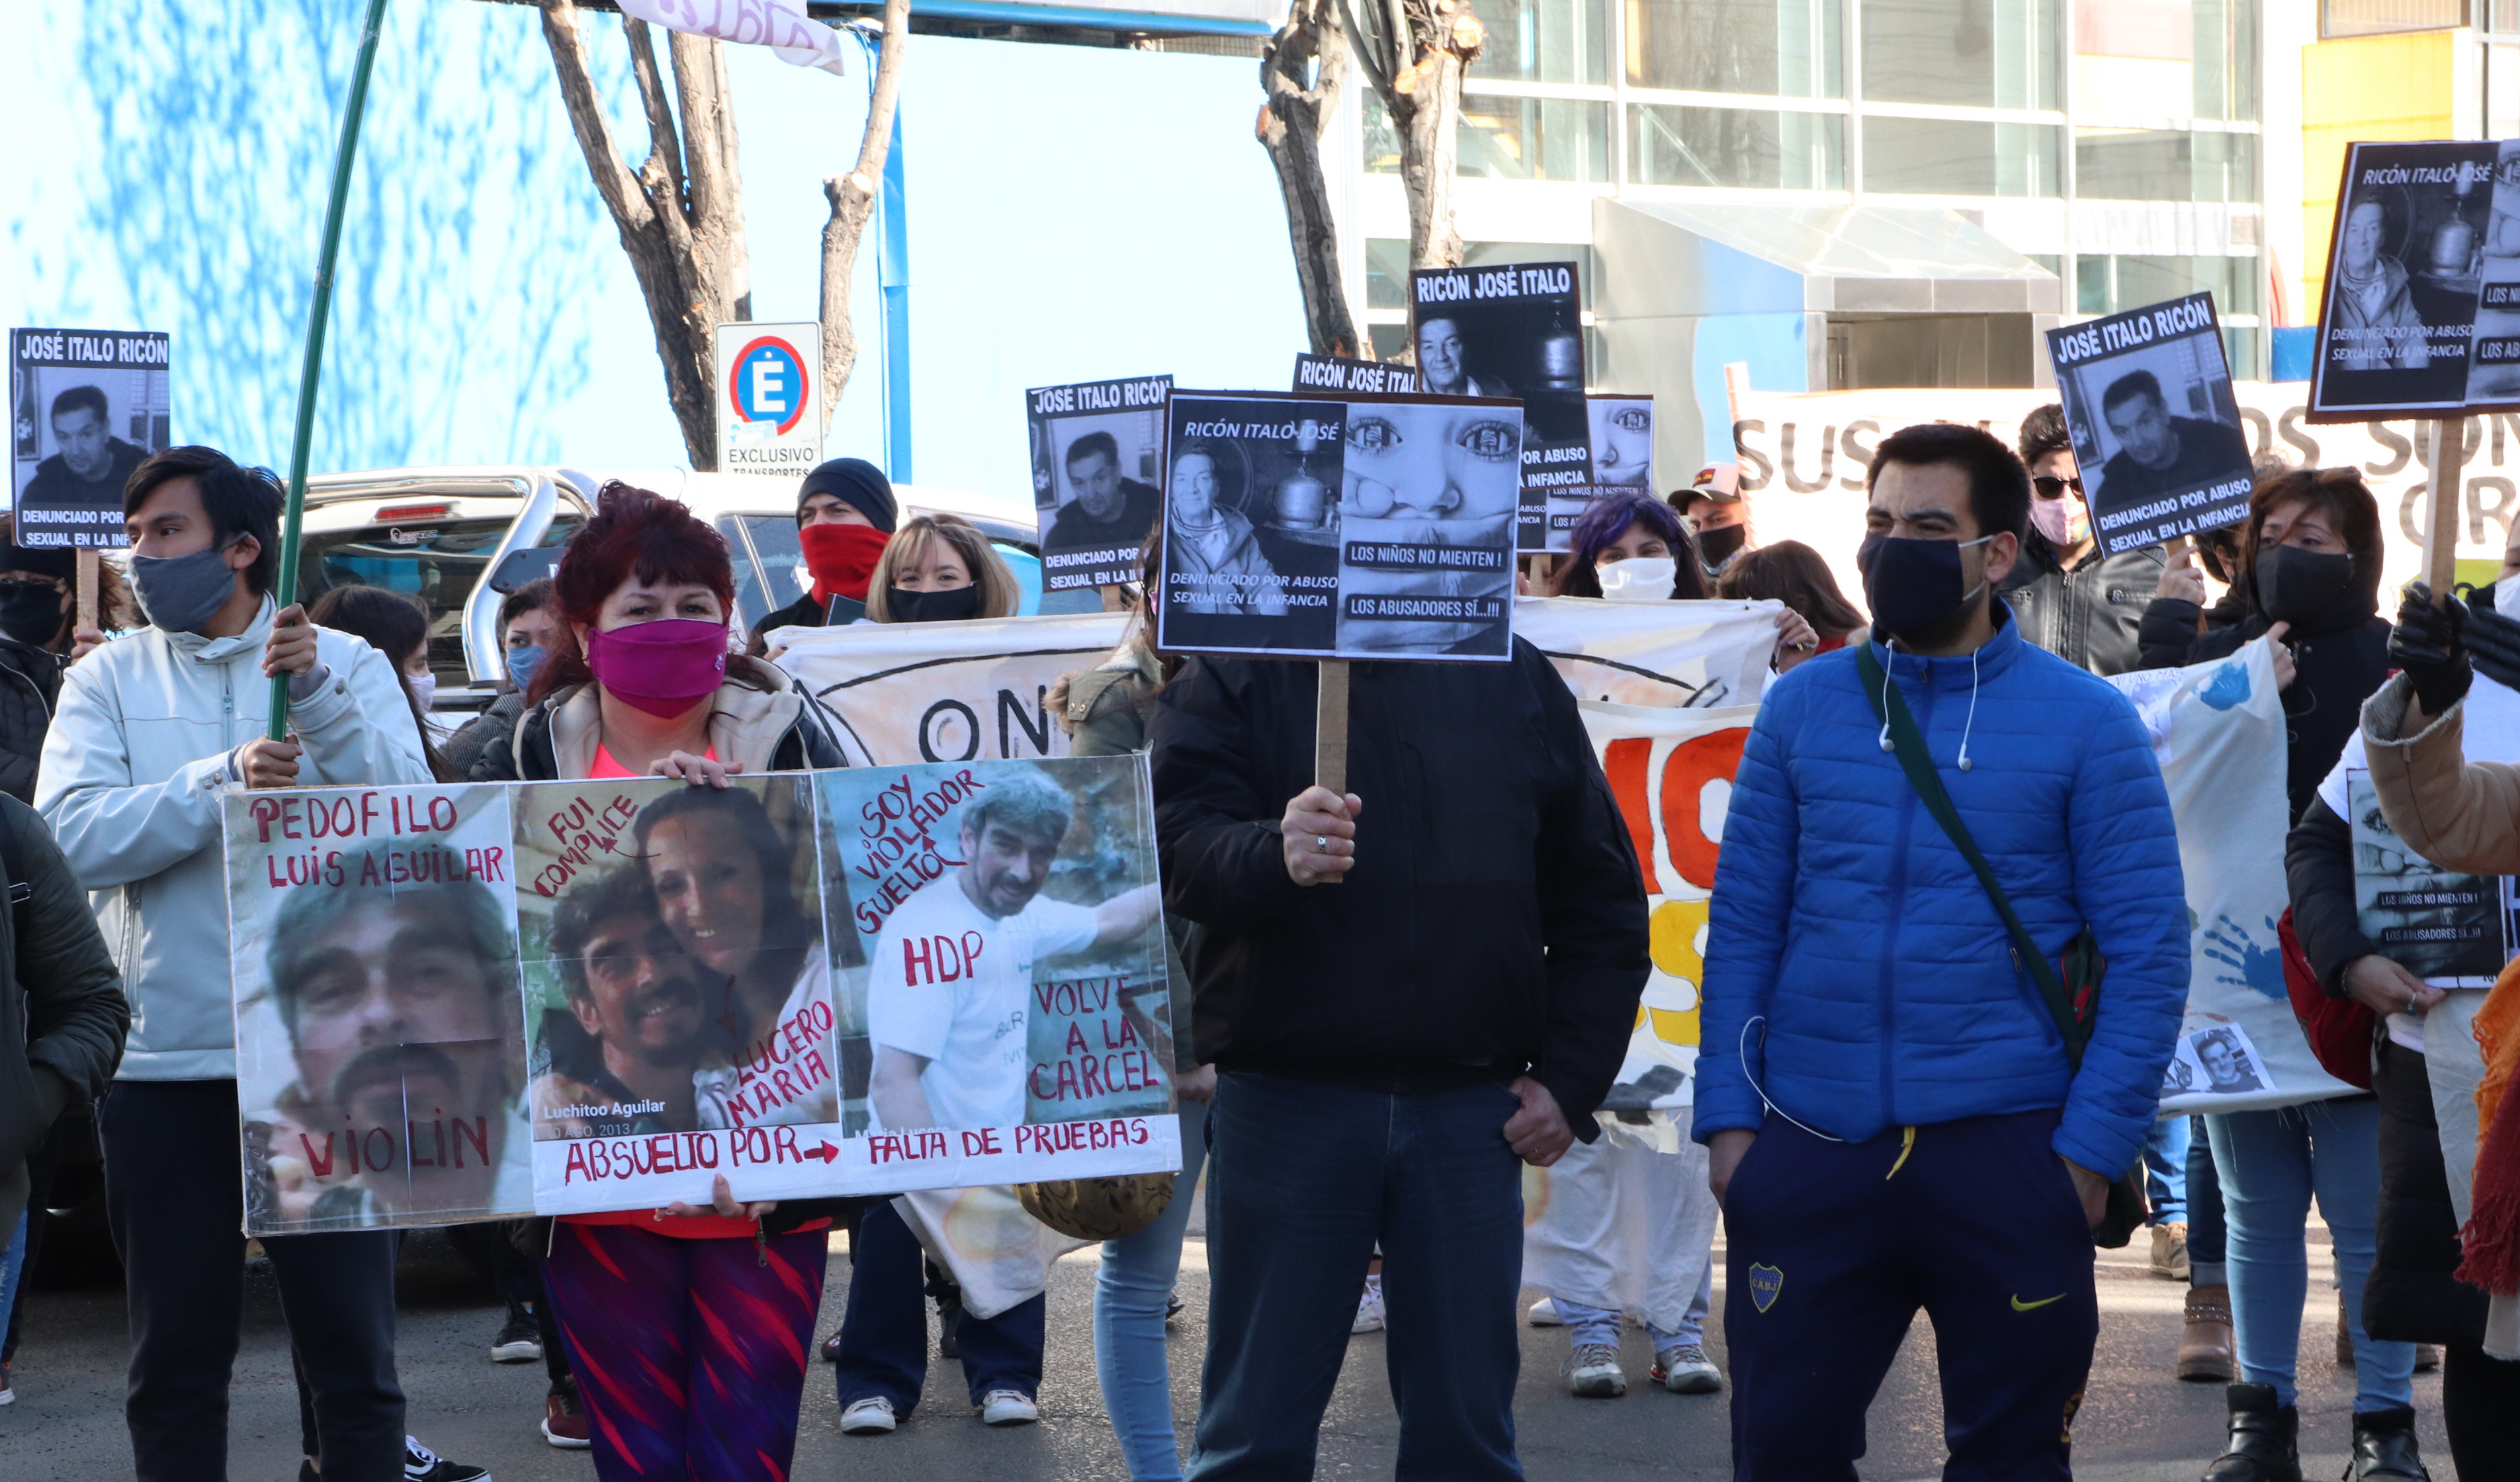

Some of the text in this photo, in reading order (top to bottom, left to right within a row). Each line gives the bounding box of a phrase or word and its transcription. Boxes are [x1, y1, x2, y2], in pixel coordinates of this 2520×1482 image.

[2363, 163, 2410, 185] RICÓN
[1417, 266, 1571, 303] RICÓN JOSÉ ITALO
[2486, 286, 2508, 303] LOS
[2057, 297, 2212, 365] JOSÉ ITALO RICÓN
[2331, 324, 2474, 341] DENUNCIADO POR ABUSO
[21, 331, 169, 364] JOSÉ ITALO RICÓN
[2331, 344, 2465, 361] SEXUAL EN LA INFANCIA
[2481, 341, 2503, 359] LOS
[752, 361, 786, 412] E
[1300, 358, 1345, 388] RICÓN
[1347, 365, 1385, 392] JOSÉ
[1034, 386, 1074, 414] JOSÉ
[1077, 384, 1121, 410] ITALO
[1184, 418, 1241, 439] RICÓN
[1298, 421, 1340, 442] JOSÉ
[729, 447, 814, 463] EXCLUSIVO
[1521, 447, 1588, 464] OR ABUSO
[1527, 470, 1586, 488] INFANCIA
[22, 509, 125, 525] DENUNCIADO POR
[2099, 477, 2252, 531] DENUNCIADO POR ABUSO
[1554, 517, 1569, 527] LOS
[2108, 501, 2251, 553] SEXUAL EN LA INFANCIA
[26, 532, 72, 546] SEXUAL
[74, 533, 91, 546] EN
[93, 533, 109, 546] LA
[1045, 549, 1115, 568] DENUNCIADO
[1350, 546, 1375, 561] LOS
[1377, 544, 1416, 563] NIÑOS
[1418, 548, 1436, 564] NO
[1439, 548, 1495, 568] MIENTEN
[1050, 572, 1093, 590] SEXUAL
[1095, 571, 1111, 585] EN
[1113, 570, 1128, 583] LA
[1170, 572, 1338, 590] DENUNCIADO POR ABUSO
[1172, 591, 1329, 607] SEXUAL EN LA INFANCIA
[1350, 600, 1377, 615] LOS
[1378, 599, 1462, 618] ABUSADORES
[249, 791, 458, 844] PEDOFILO
[859, 773, 916, 840] SOY
[547, 796, 595, 846] FUI
[855, 768, 986, 881] VIOLADOR
[533, 794, 639, 898] COMPLICE
[267, 844, 505, 889] LUIS AGUILAR
[855, 847, 945, 935] SUELTO
[2381, 895, 2397, 906] LOS
[2398, 892, 2423, 904] NIÑOS
[2424, 893, 2437, 904] NO
[2437, 893, 2474, 904] MIENTEN
[2386, 930, 2402, 942] LOS
[2403, 928, 2457, 940] ABUSADORES
[902, 930, 984, 987] HDP
[731, 1000, 834, 1087] LUCERO
[1066, 1020, 1088, 1055] A
[1102, 1014, 1137, 1050] LA
[726, 1049, 831, 1129] MARIA
[1028, 1049, 1160, 1102] CARCEL
[544, 1099, 666, 1119] Luchitoo Aguilar
[299, 1108, 491, 1177] VIOLIN
[599, 1123, 630, 1137] 2013
[868, 1117, 1149, 1165] FALTA DE PRUEBAS
[564, 1125, 804, 1186] ABSUELTO POR
[1752, 1278, 1778, 1292] CABJ
